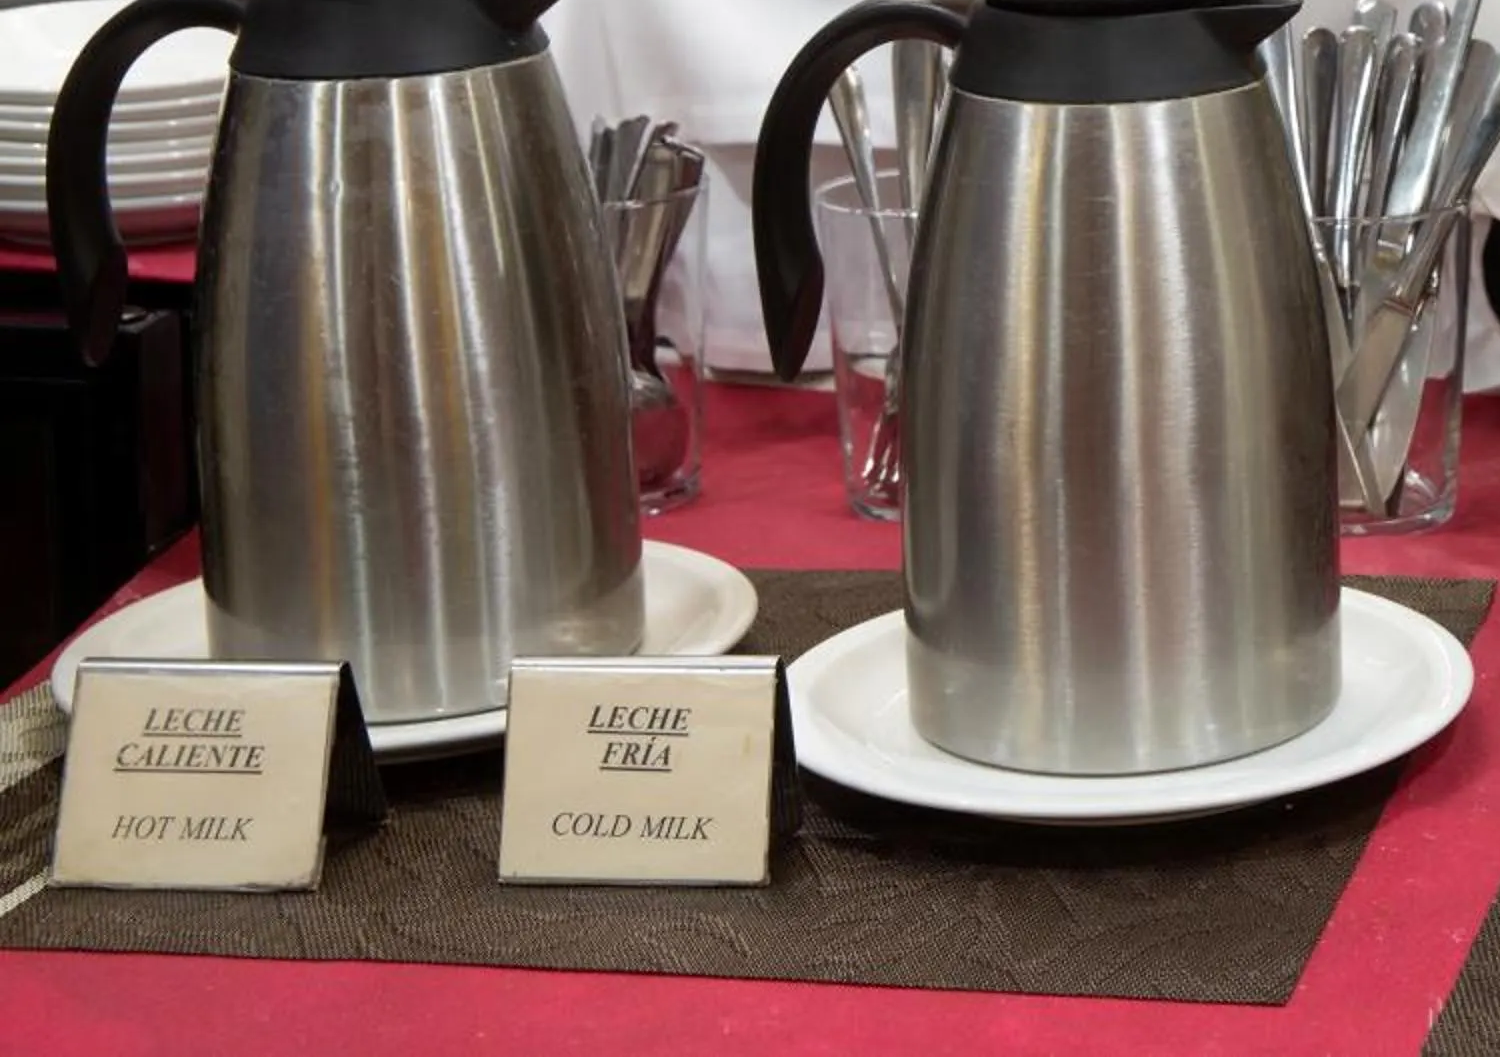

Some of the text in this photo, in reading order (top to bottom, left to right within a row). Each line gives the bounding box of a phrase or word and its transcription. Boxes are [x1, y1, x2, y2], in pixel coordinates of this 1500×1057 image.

[142, 707, 246, 737] LECHE
[586, 705, 693, 736] LECHE
[113, 743, 265, 774] CALIENTE
[599, 737, 673, 772] FRÍA
[111, 815, 254, 841] HOT MILK
[551, 813, 713, 840] COLD MILK
